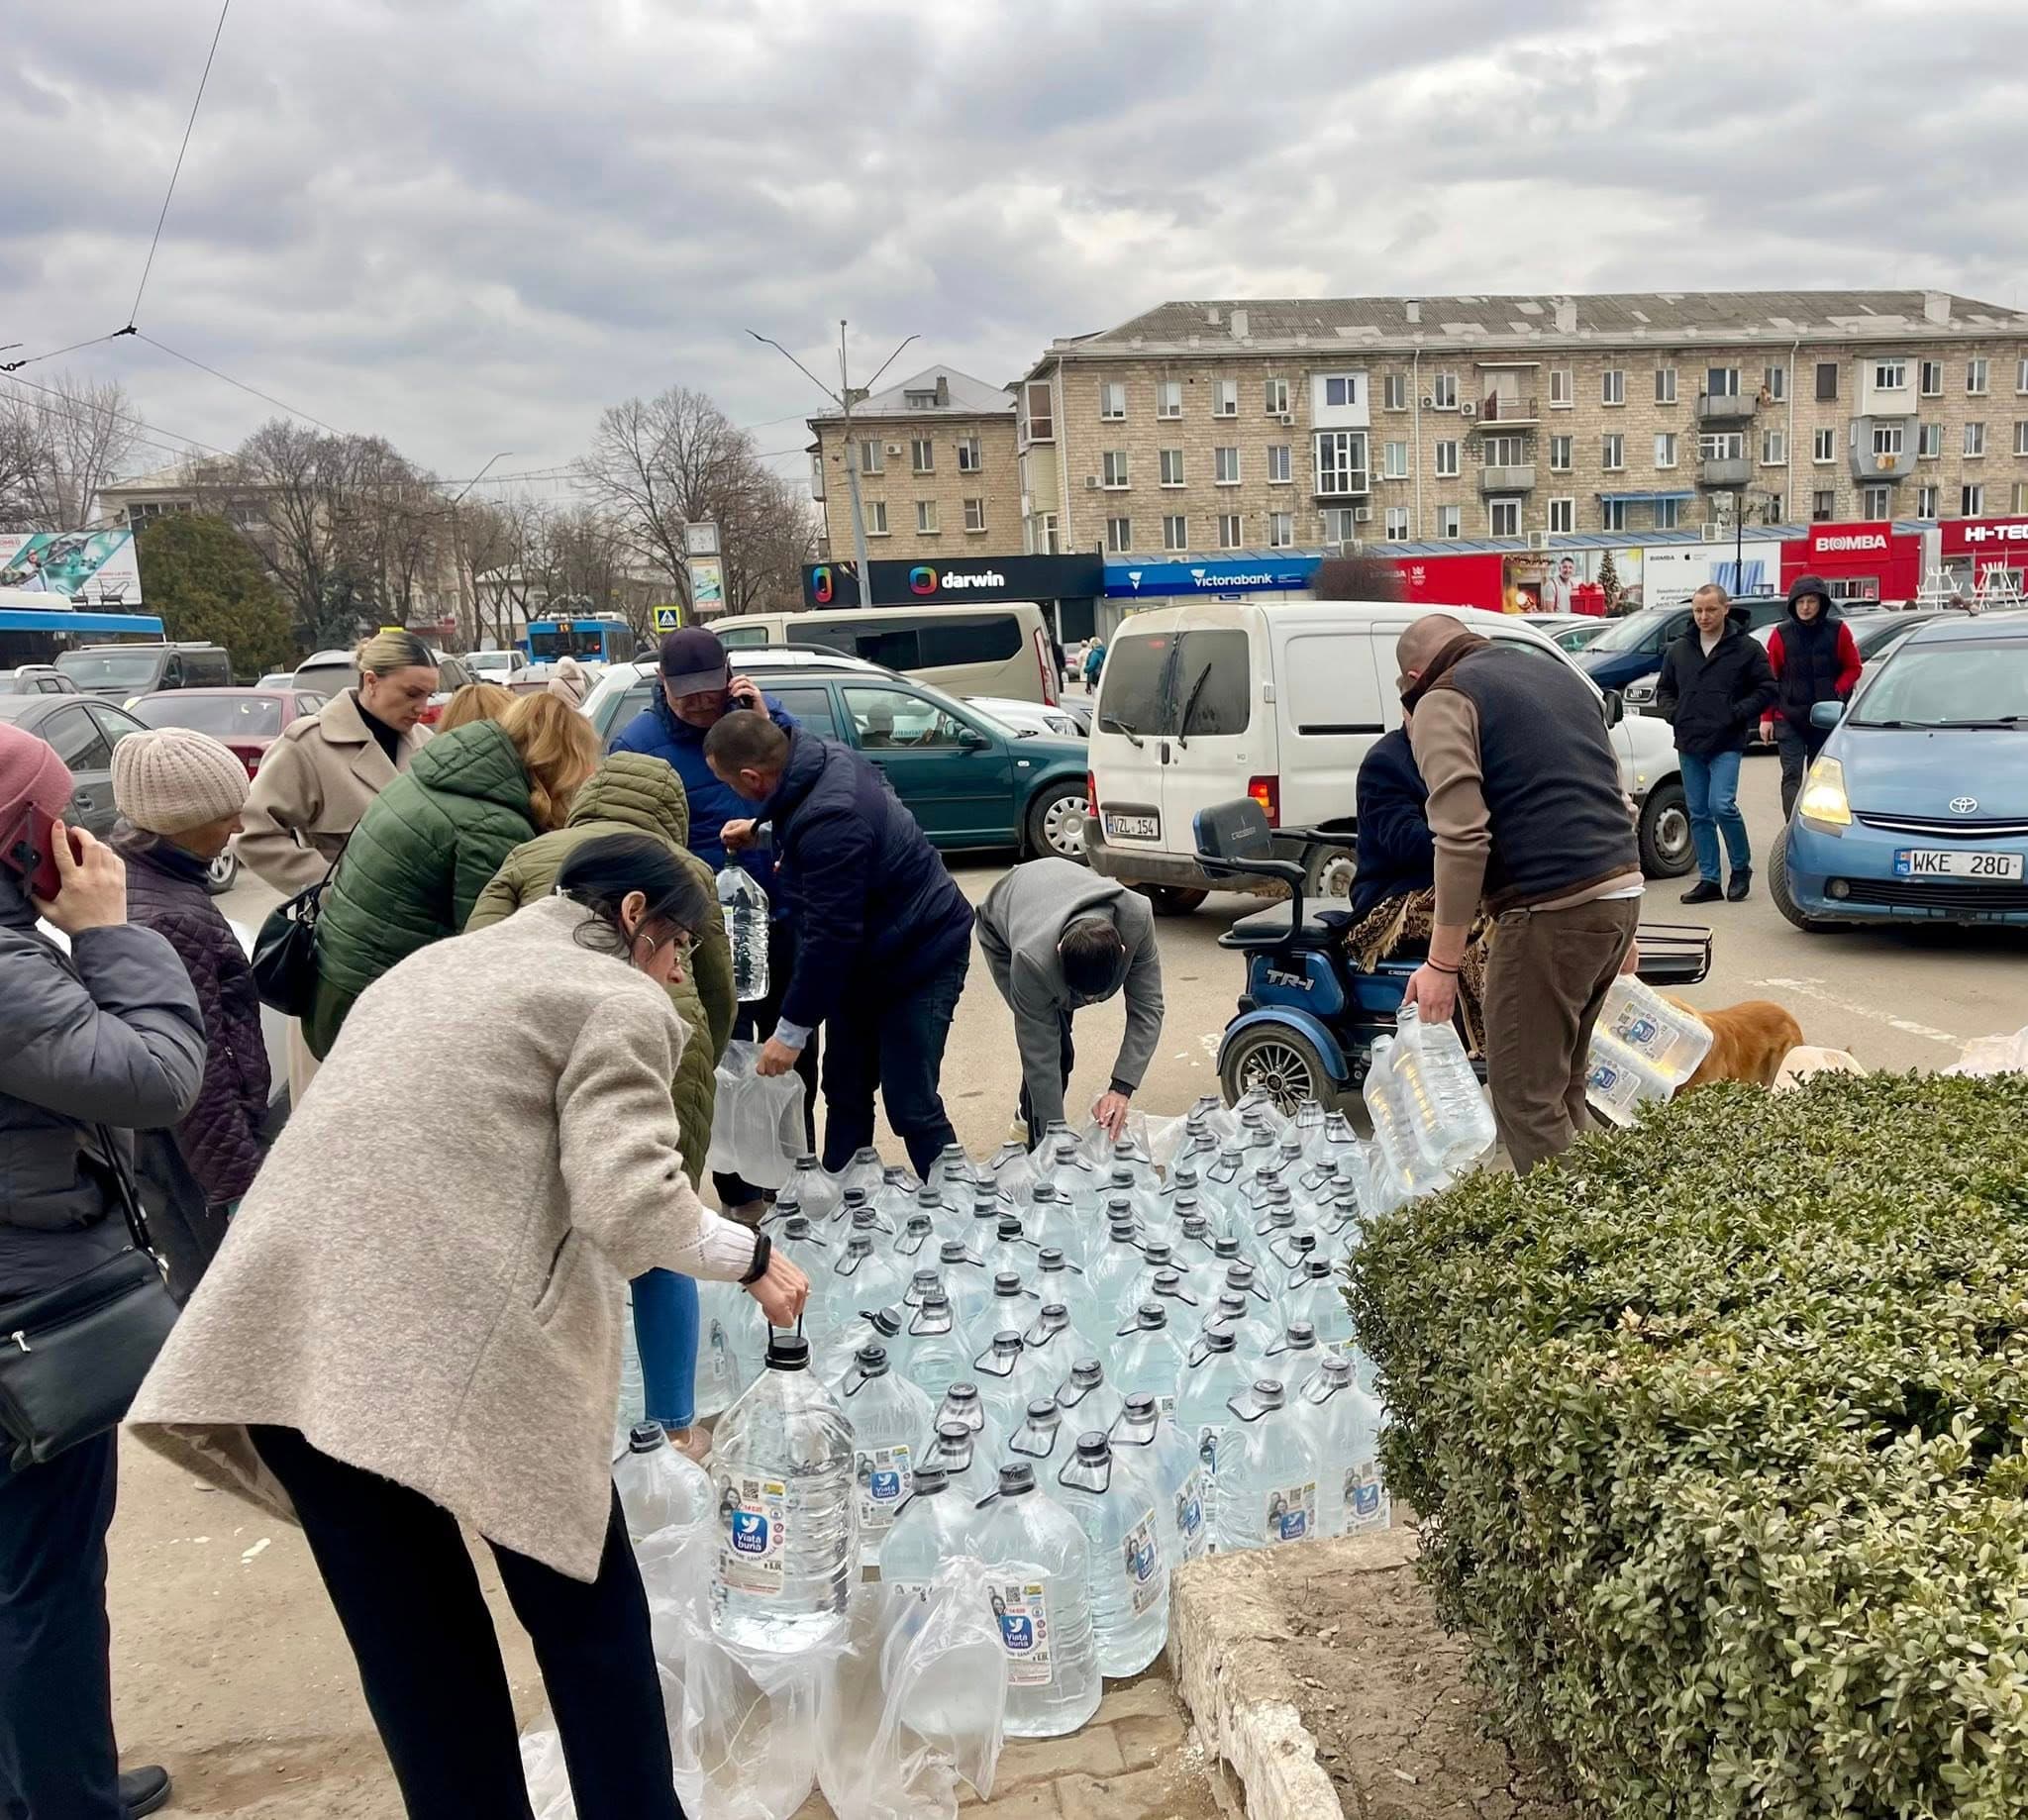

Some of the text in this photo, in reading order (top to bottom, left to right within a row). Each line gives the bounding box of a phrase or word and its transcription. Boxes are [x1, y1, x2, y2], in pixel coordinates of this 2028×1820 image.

[1815, 534, 1887, 553] BOMBA
[941, 569, 1005, 589] darwin
[1192, 571, 1273, 587] Victoriabank
[1113, 817, 1131, 833] VZL
[1137, 819, 1154, 835] 154
[1913, 852, 1952, 872] WKE
[1970, 856, 2010, 875] 280
[1267, 968, 1315, 991] TR-1
